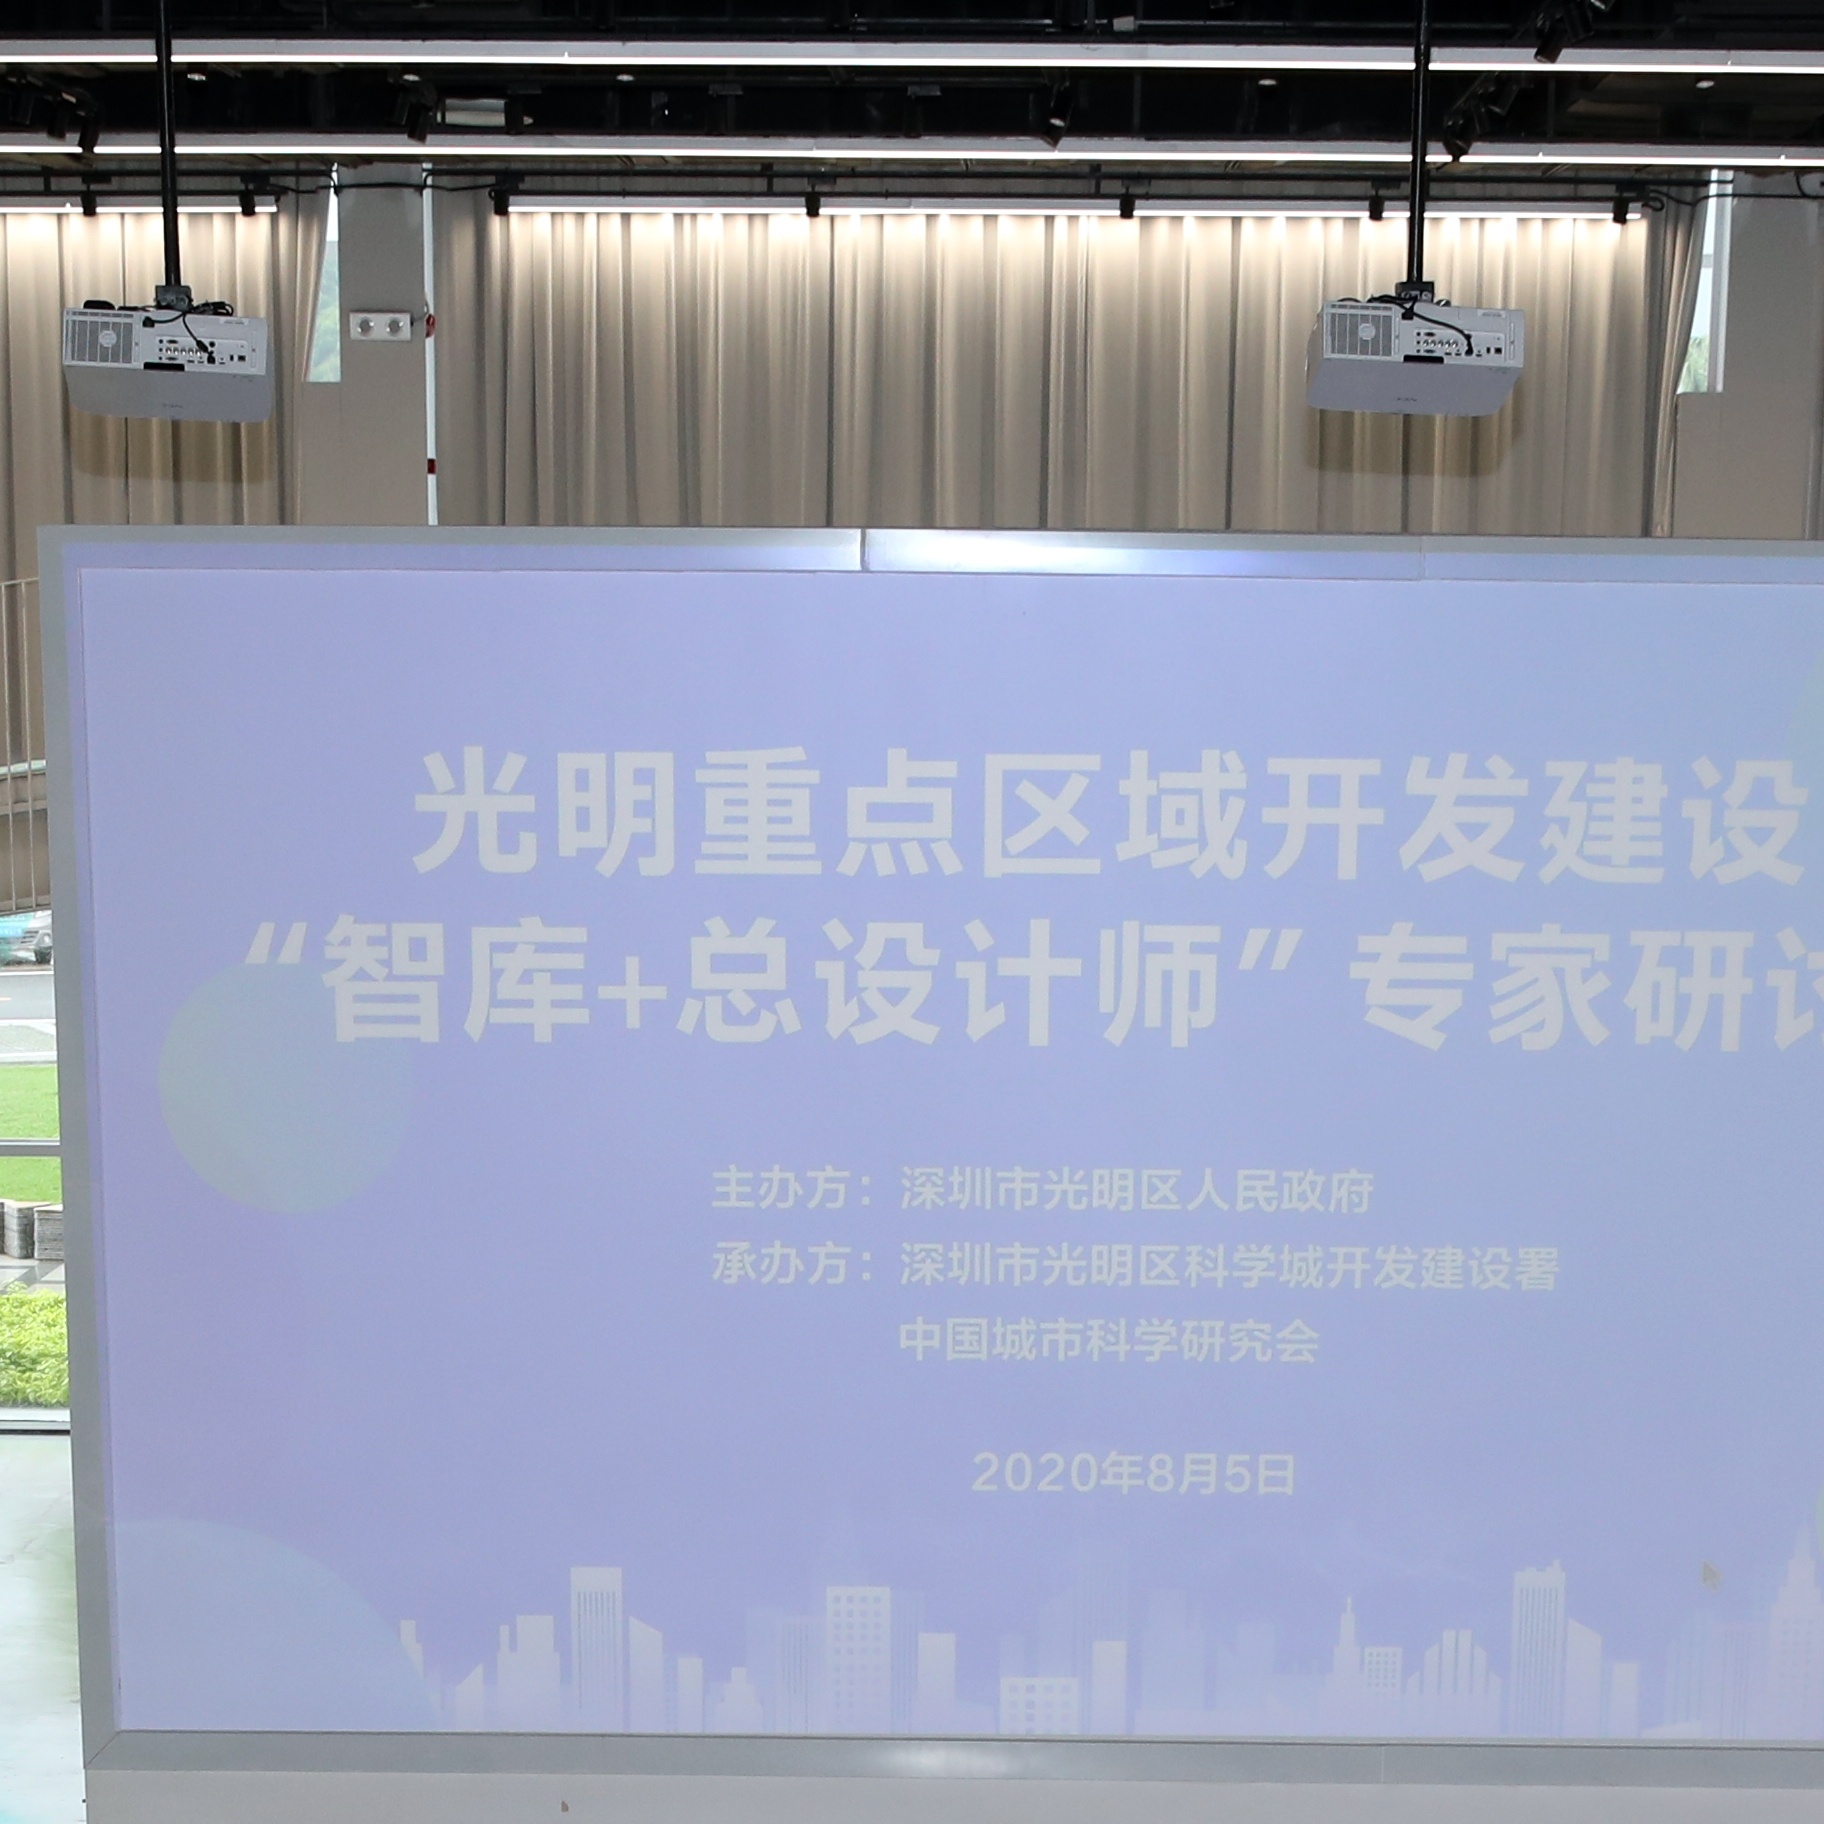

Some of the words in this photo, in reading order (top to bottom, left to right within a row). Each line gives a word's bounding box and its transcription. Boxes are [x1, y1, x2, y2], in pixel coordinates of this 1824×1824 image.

[411, 744, 1812, 886] 光明重点区域开发建设
[900, 1317, 1318, 1365] 中国城市科学研究会
[971, 1449, 1296, 1496] 2020年8月5日
